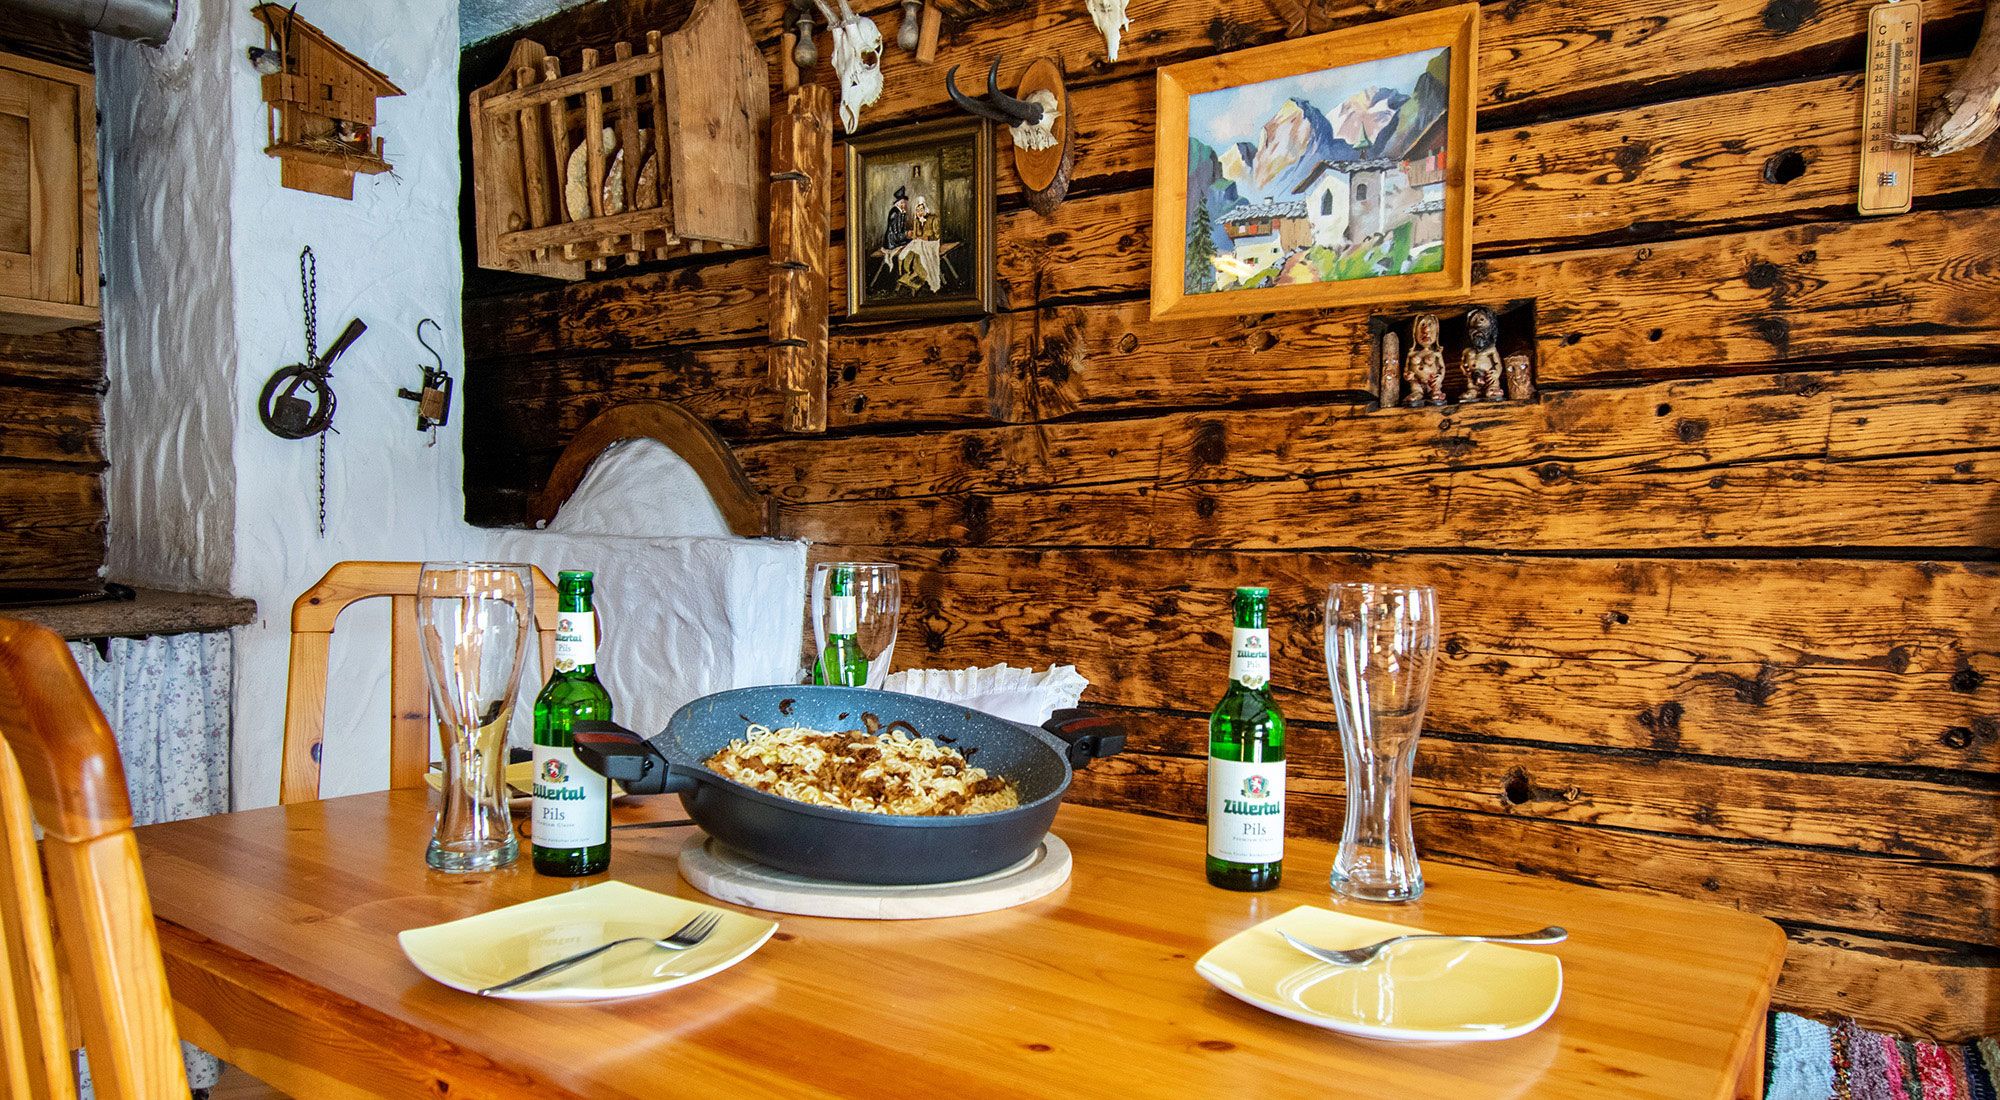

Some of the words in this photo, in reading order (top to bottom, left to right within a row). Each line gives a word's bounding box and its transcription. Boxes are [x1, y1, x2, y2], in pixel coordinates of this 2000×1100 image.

[543, 807, 565, 820] Pils
[1224, 799, 1280, 815] Zillertal
[1243, 823, 1266, 835] Pils
